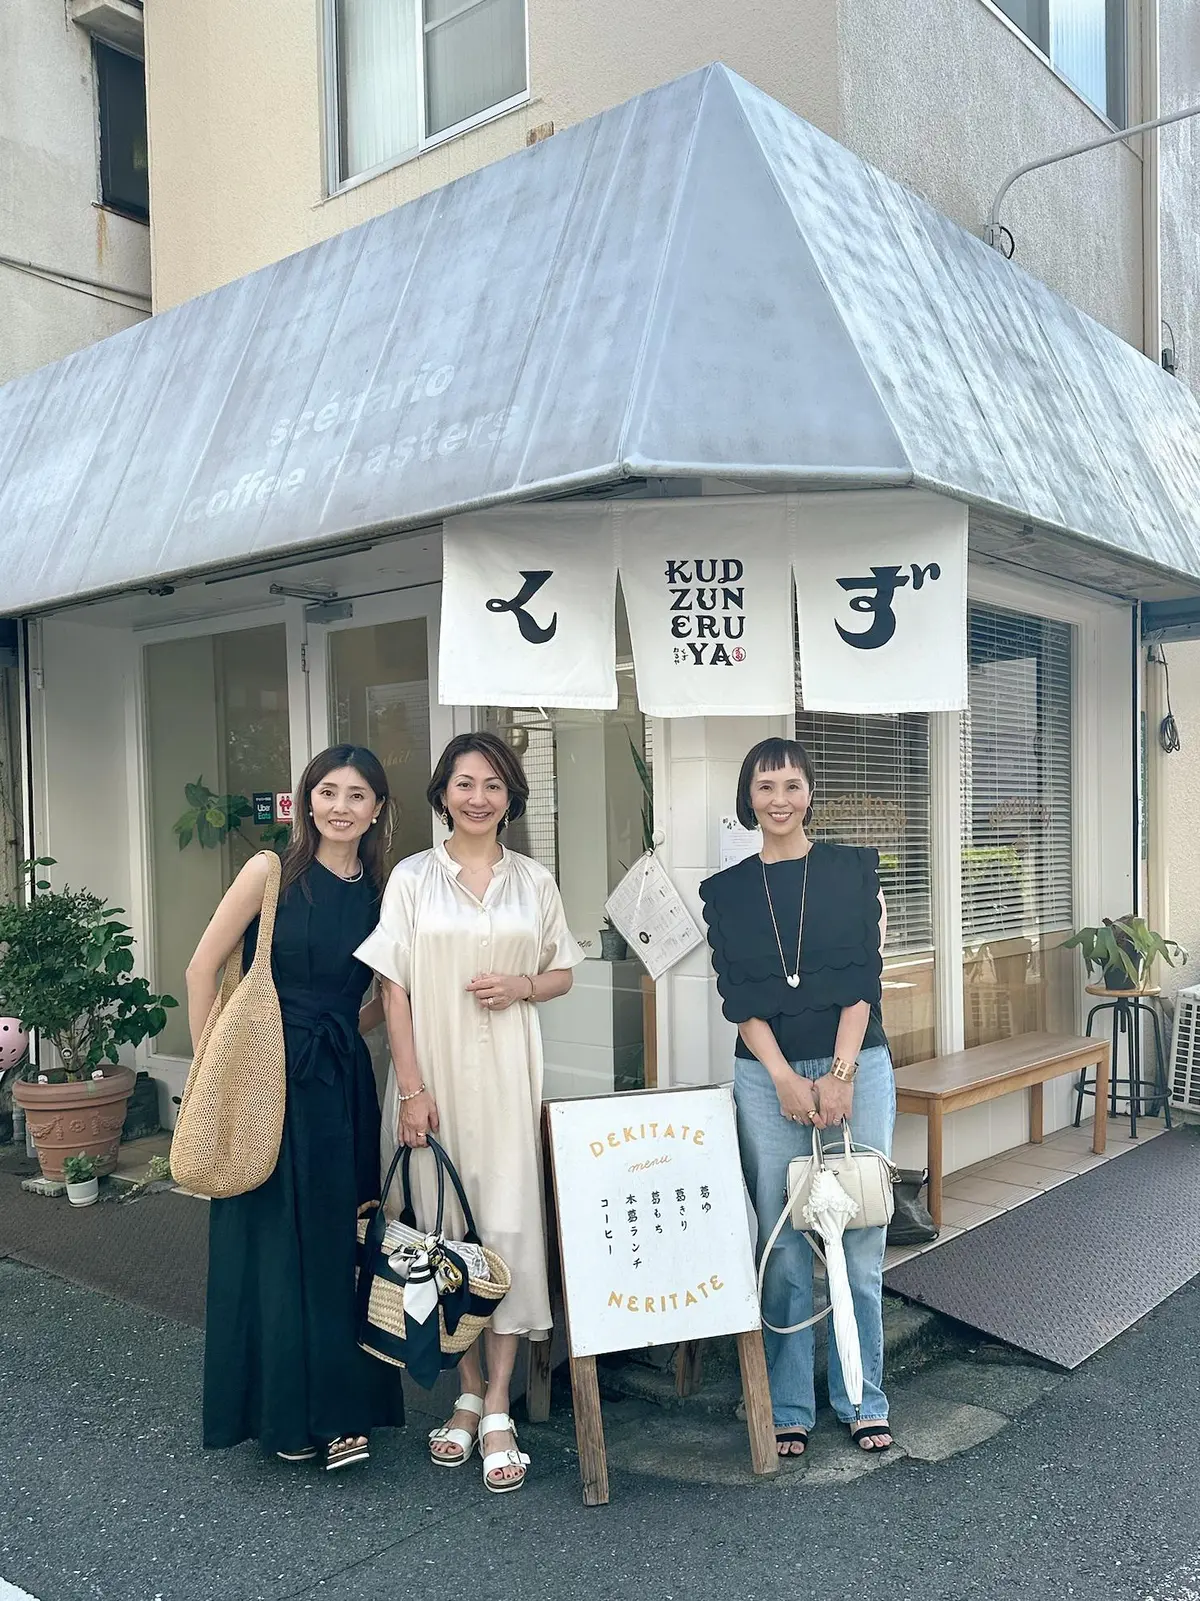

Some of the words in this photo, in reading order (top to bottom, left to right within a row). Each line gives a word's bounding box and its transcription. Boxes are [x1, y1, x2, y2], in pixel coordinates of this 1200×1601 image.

[266, 363, 456, 448] scénario
[184, 466, 307, 525] coffee
[314, 405, 522, 482] roasters
[664, 558, 744, 584] KUD
[485, 569, 558, 645] く
[668, 587, 745, 611] ZUN
[833, 561, 941, 650] ず
[670, 614, 746, 640] ERU
[686, 642, 734, 667] YA
[257, 803, 271, 812] Uber
[589, 1122, 706, 1158] DEKITATE
[628, 1154, 672, 1173] menu
[600, 1198, 613, 1256] コーヒー
[650, 1190, 663, 1234] 葛もち
[674, 1187, 688, 1232] 葛きり
[607, 1274, 725, 1314] NERITATE
